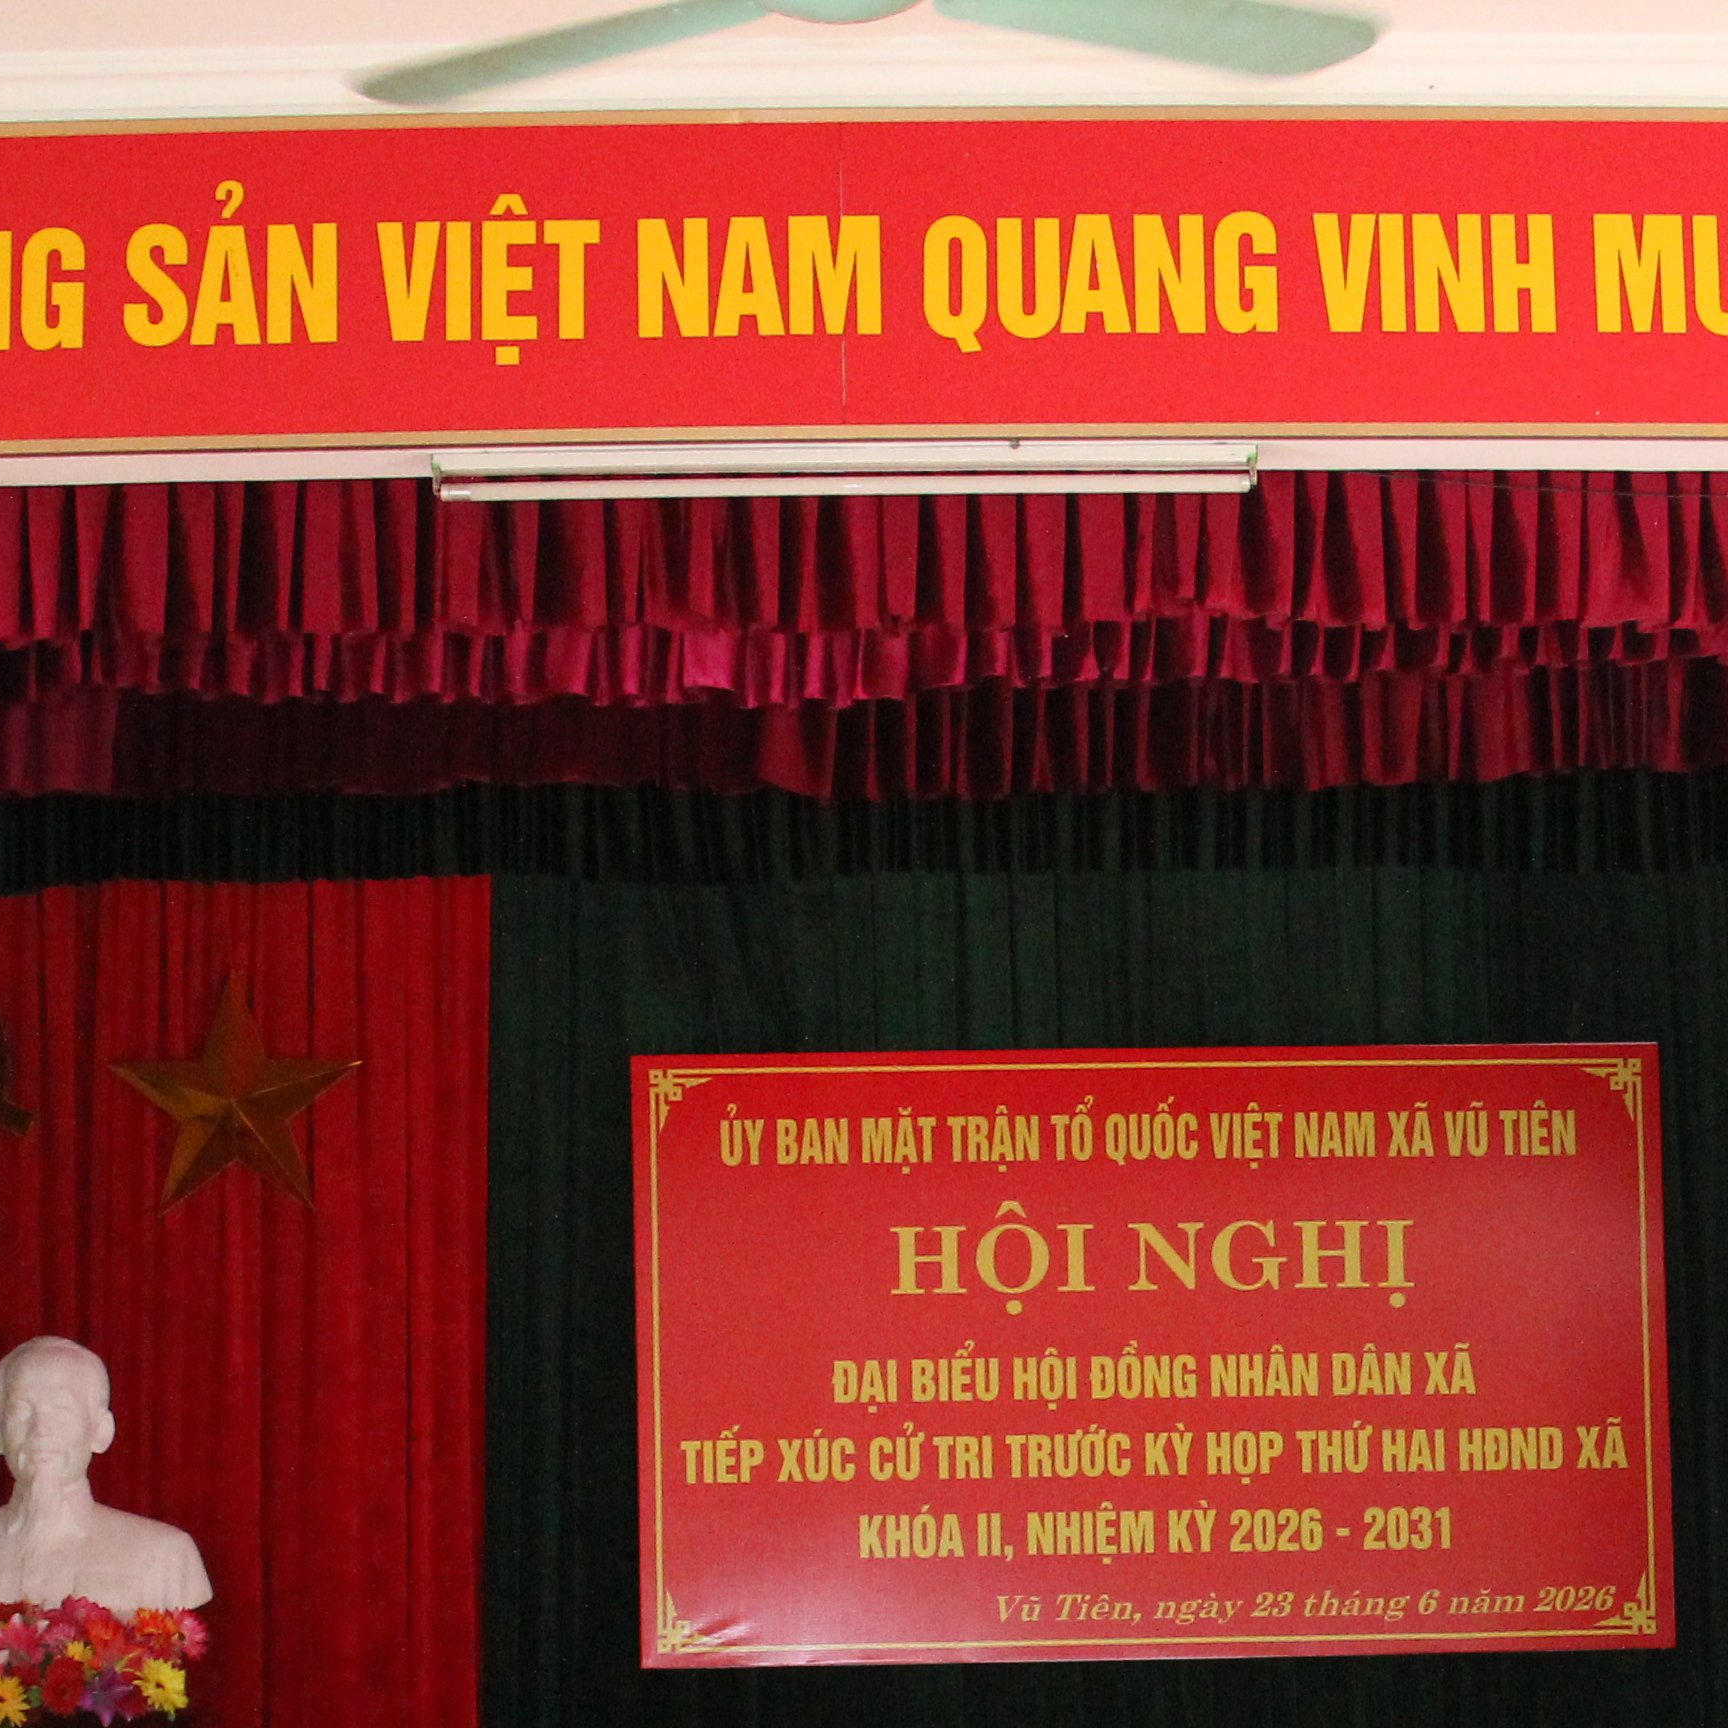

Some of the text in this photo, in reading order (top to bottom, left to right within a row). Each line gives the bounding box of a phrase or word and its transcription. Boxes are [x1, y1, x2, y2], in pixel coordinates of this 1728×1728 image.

[124, 181, 337, 346] SẢN
[377, 194, 600, 364] VIỆT
[638, 216, 881, 337] NAM
[924, 212, 1278, 352] QUANG
[1313, 214, 1556, 332] VINH
[720, 1095, 1576, 1174] ỦY BAN MẶT TRẬN TỔ QUỐC VIỆT NAM XÃ VŨ TIÊN
[890, 1200, 1415, 1316] HỘI NGHỊ
[831, 1339, 1476, 1414] ĐẠI BIỂU HỘI ĐỒNG NHÂN DÂN XÃ
[680, 1417, 1628, 1485] TIẾP XÚC CỬ TRI TRƯỚC KỲ HỌP THỨ HAI HĐND XÃ
[858, 1504, 965, 1559] KHÓA
[977, 1512, 1014, 1562] II,
[1026, 1501, 1155, 1565] NHIỆM
[1168, 1499, 1217, 1553] KỲ
[1229, 1507, 1324, 1553] 2026
[1363, 1506, 1451, 1550] 2031
[996, 1586, 1616, 1625] Vũ Tiên, ngày 23 tháng 6 năm 2026
